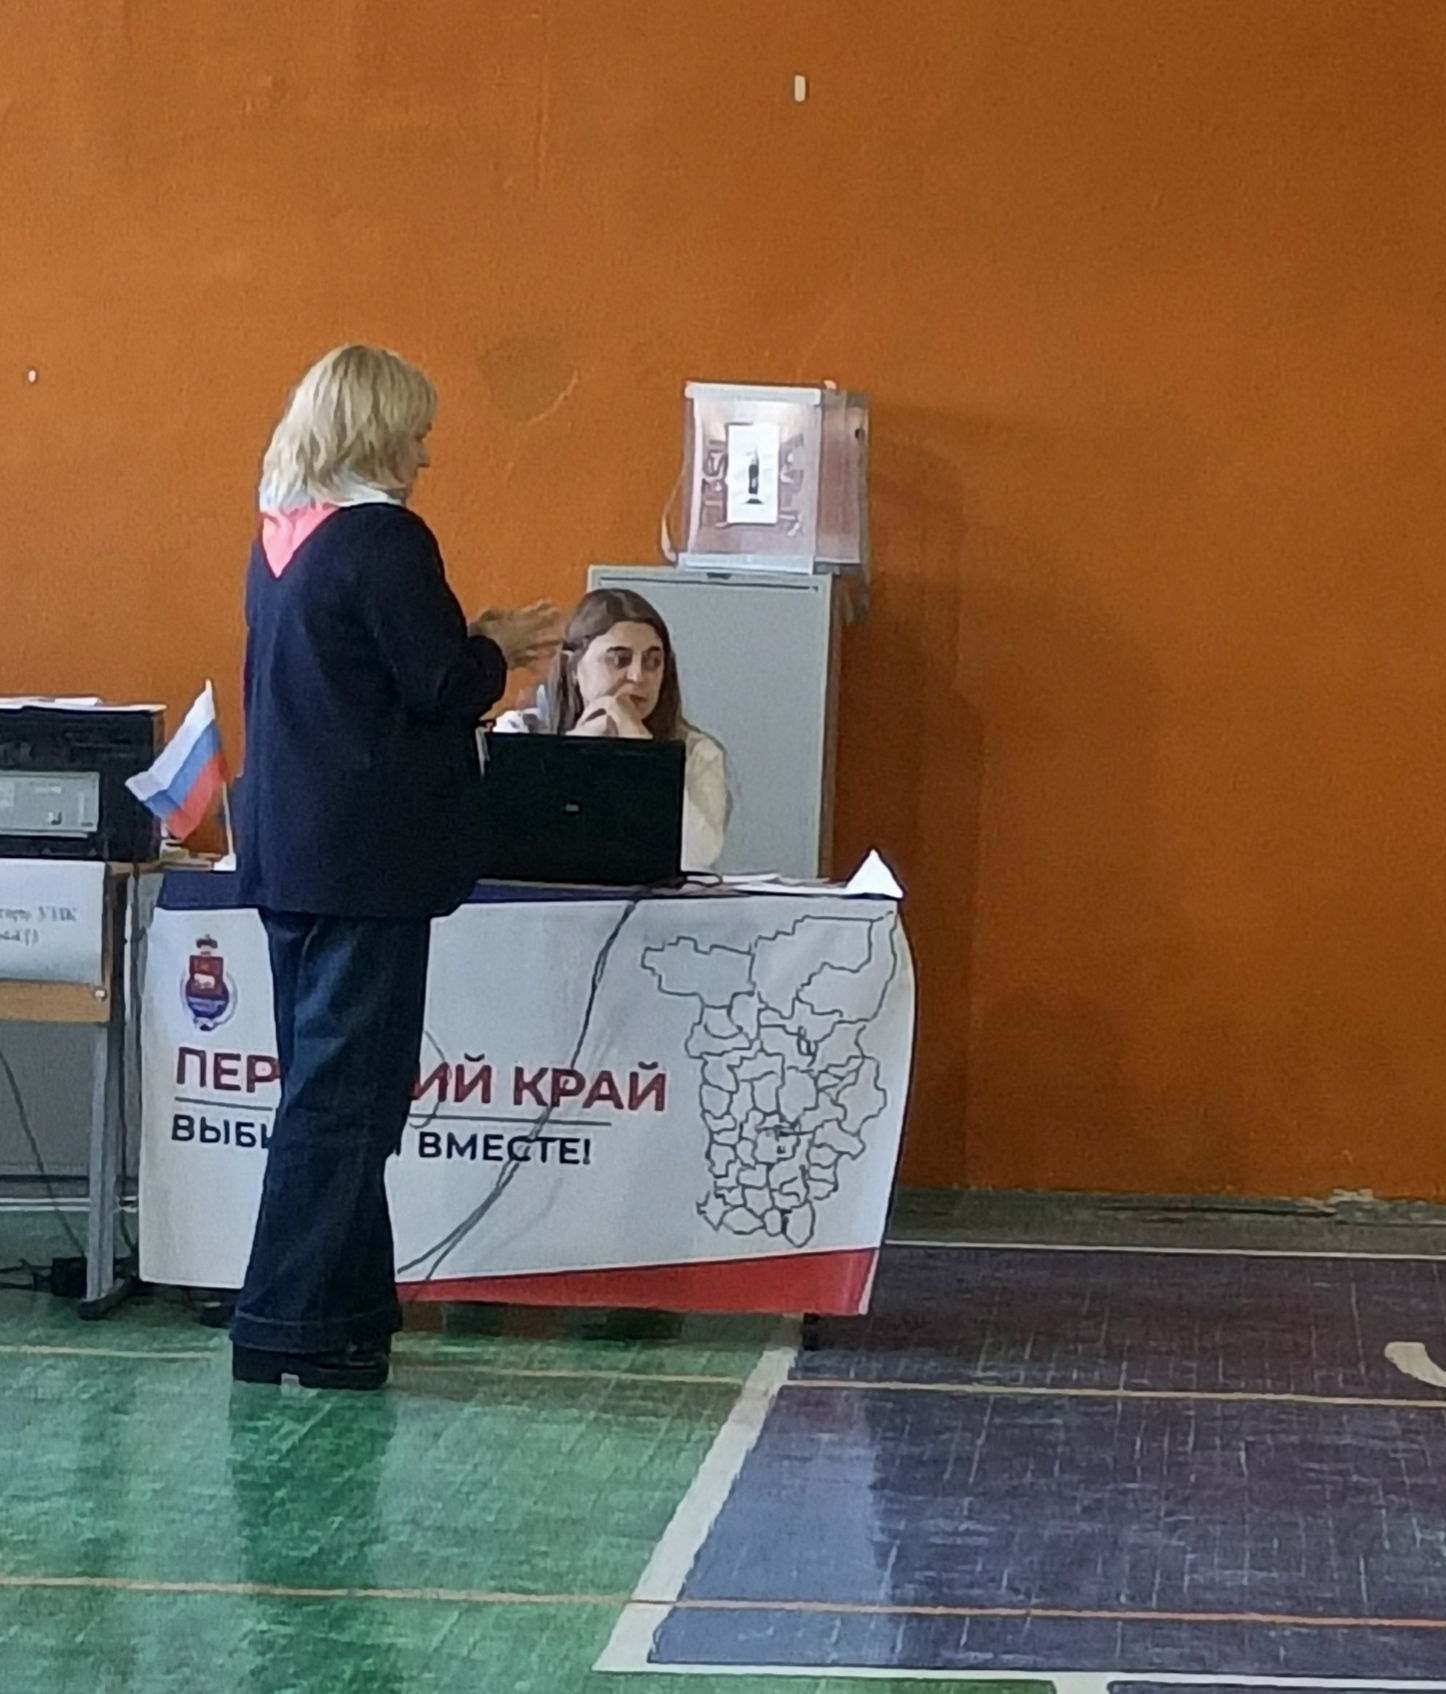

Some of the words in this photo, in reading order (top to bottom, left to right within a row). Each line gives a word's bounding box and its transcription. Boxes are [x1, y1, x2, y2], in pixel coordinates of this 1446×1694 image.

[176, 1046, 492, 1104] ПЕРИЙ
[512, 1060, 666, 1111] КРАЙ
[418, 1131, 591, 1165] ВМЕСТЕ!
